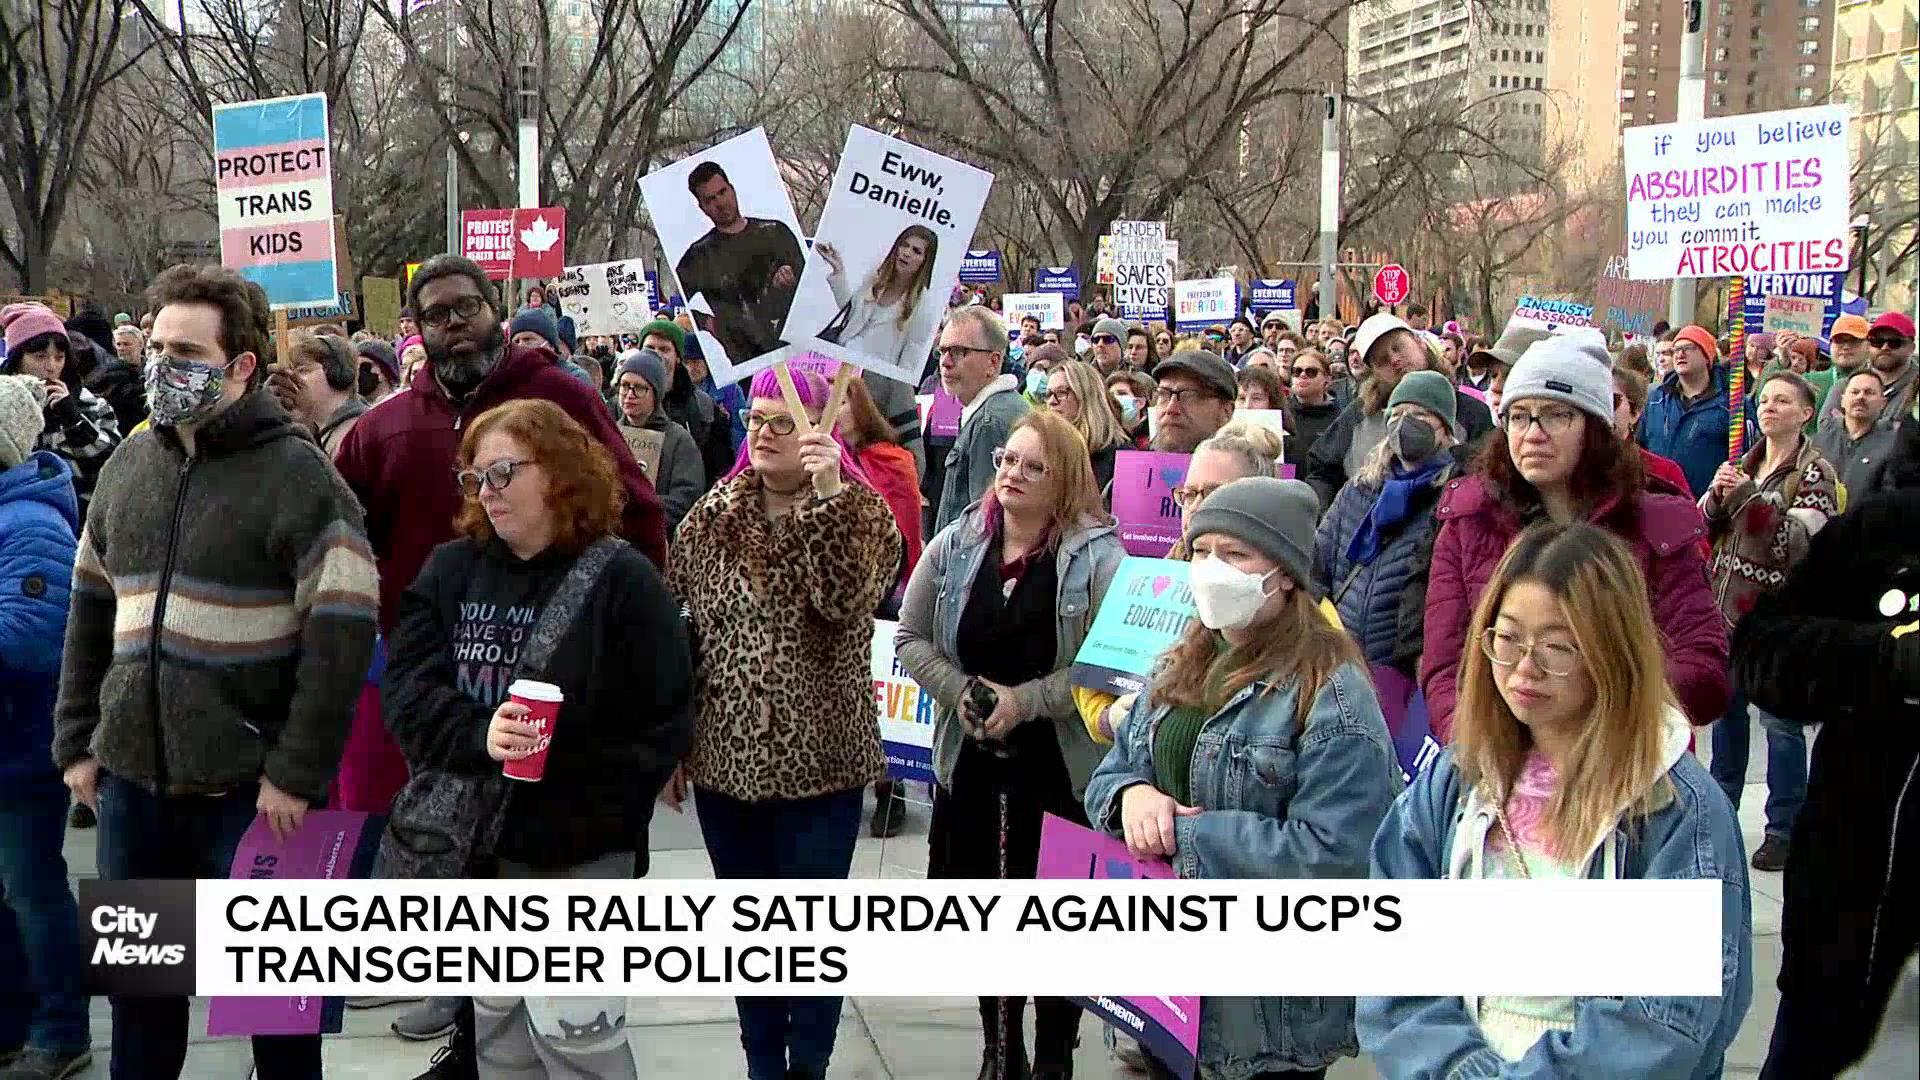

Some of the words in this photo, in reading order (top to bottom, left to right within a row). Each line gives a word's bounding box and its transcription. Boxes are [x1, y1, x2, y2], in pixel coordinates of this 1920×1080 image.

[1654, 134, 1673, 156] if
[1696, 131, 1736, 153] you
[1758, 119, 1843, 145] believe
[218, 147, 325, 179] PROTECT
[881, 151, 944, 196] Eww,
[1628, 157, 1823, 202] ABSURDITIES
[235, 189, 312, 218] TRANS
[849, 171, 956, 229] Danielle.
[1651, 201, 1701, 224] they
[1715, 201, 1751, 220] can
[1765, 192, 1822, 214] make
[250, 231, 303, 256] KIDS
[1111, 222, 1162, 237] GENDER
[1631, 230, 1668, 250] you
[1681, 220, 1761, 244] commit
[1676, 238, 1844, 276] ATROCITIES
[1116, 264, 1166, 286] SAVES
[1382, 270, 1400, 280] STOP
[1115, 287, 1168, 306] LIVES
[1147, 468, 1153, 489] I
[460, 602, 496, 622] YOU
[453, 623, 496, 641] HAVE
